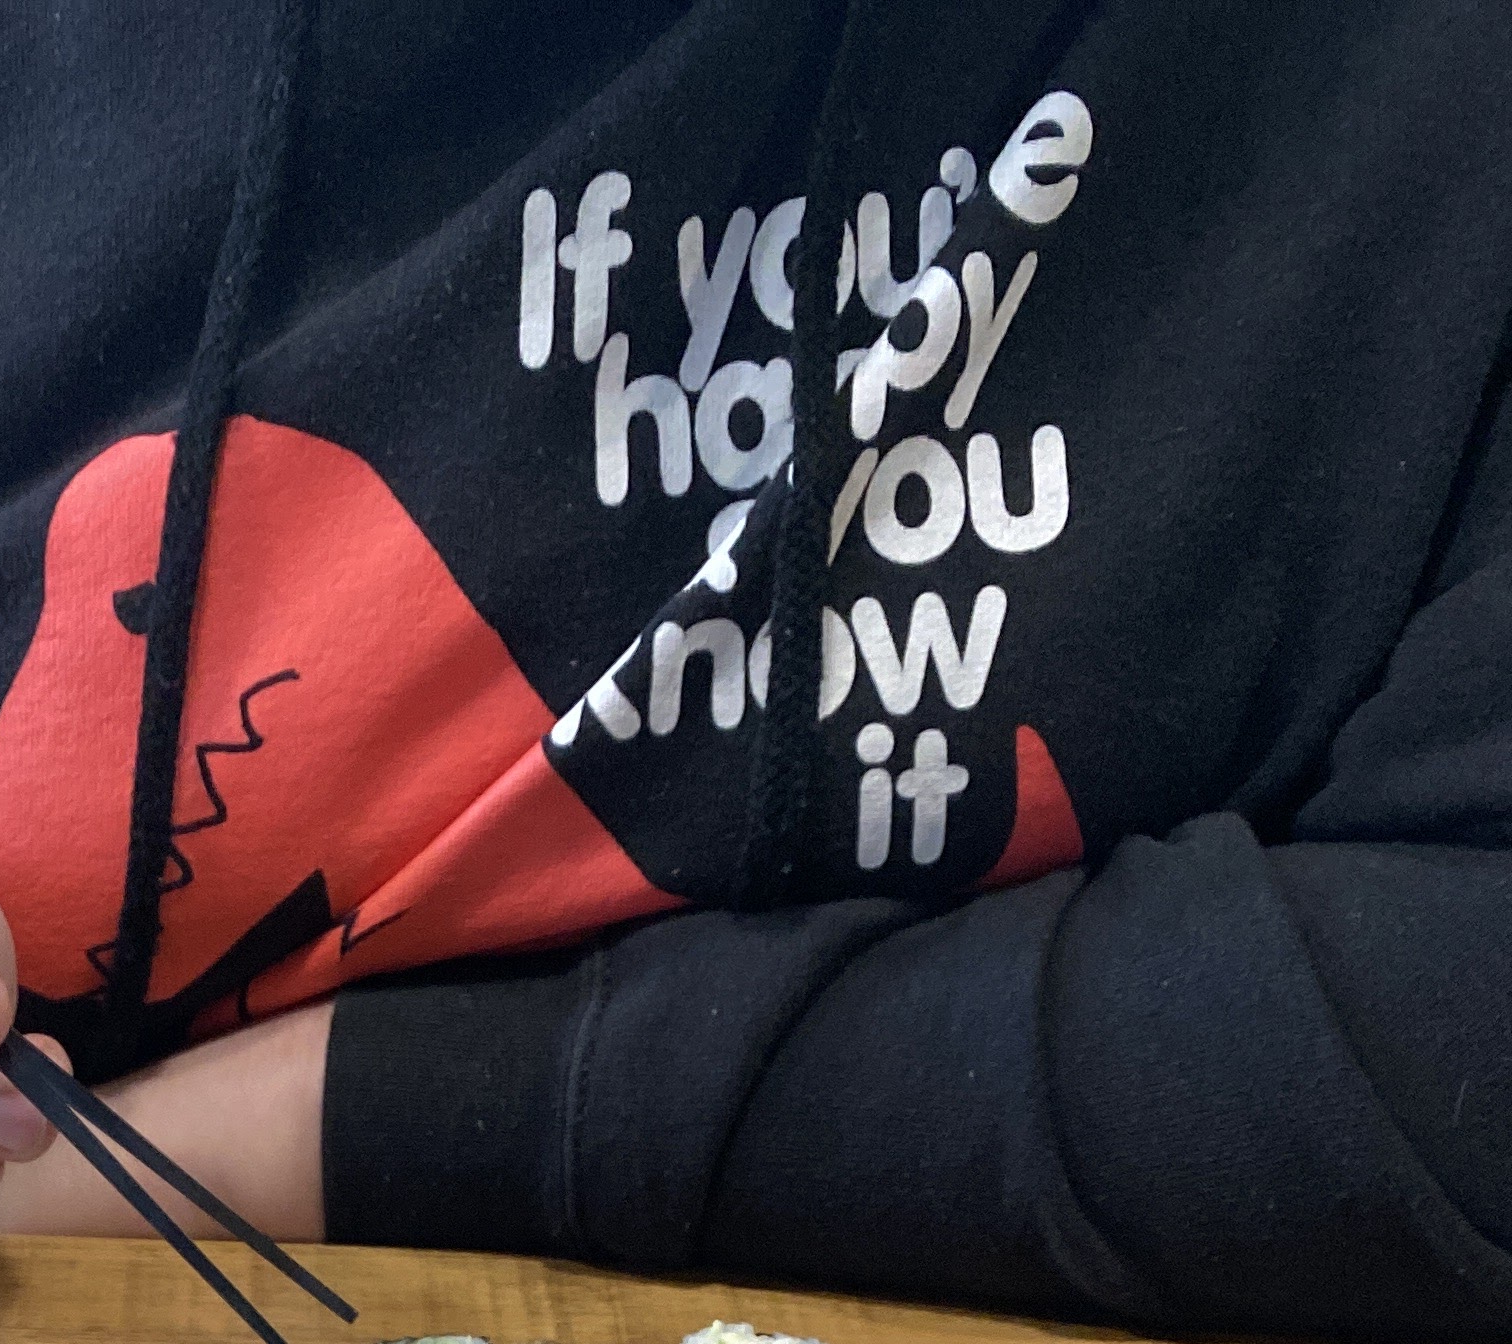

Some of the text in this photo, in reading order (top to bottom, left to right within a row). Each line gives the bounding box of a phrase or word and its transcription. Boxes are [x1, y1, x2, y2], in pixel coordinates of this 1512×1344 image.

[518, 90, 1094, 393] If you'e
[594, 250, 1039, 507] hapy
[855, 722, 970, 870] it
